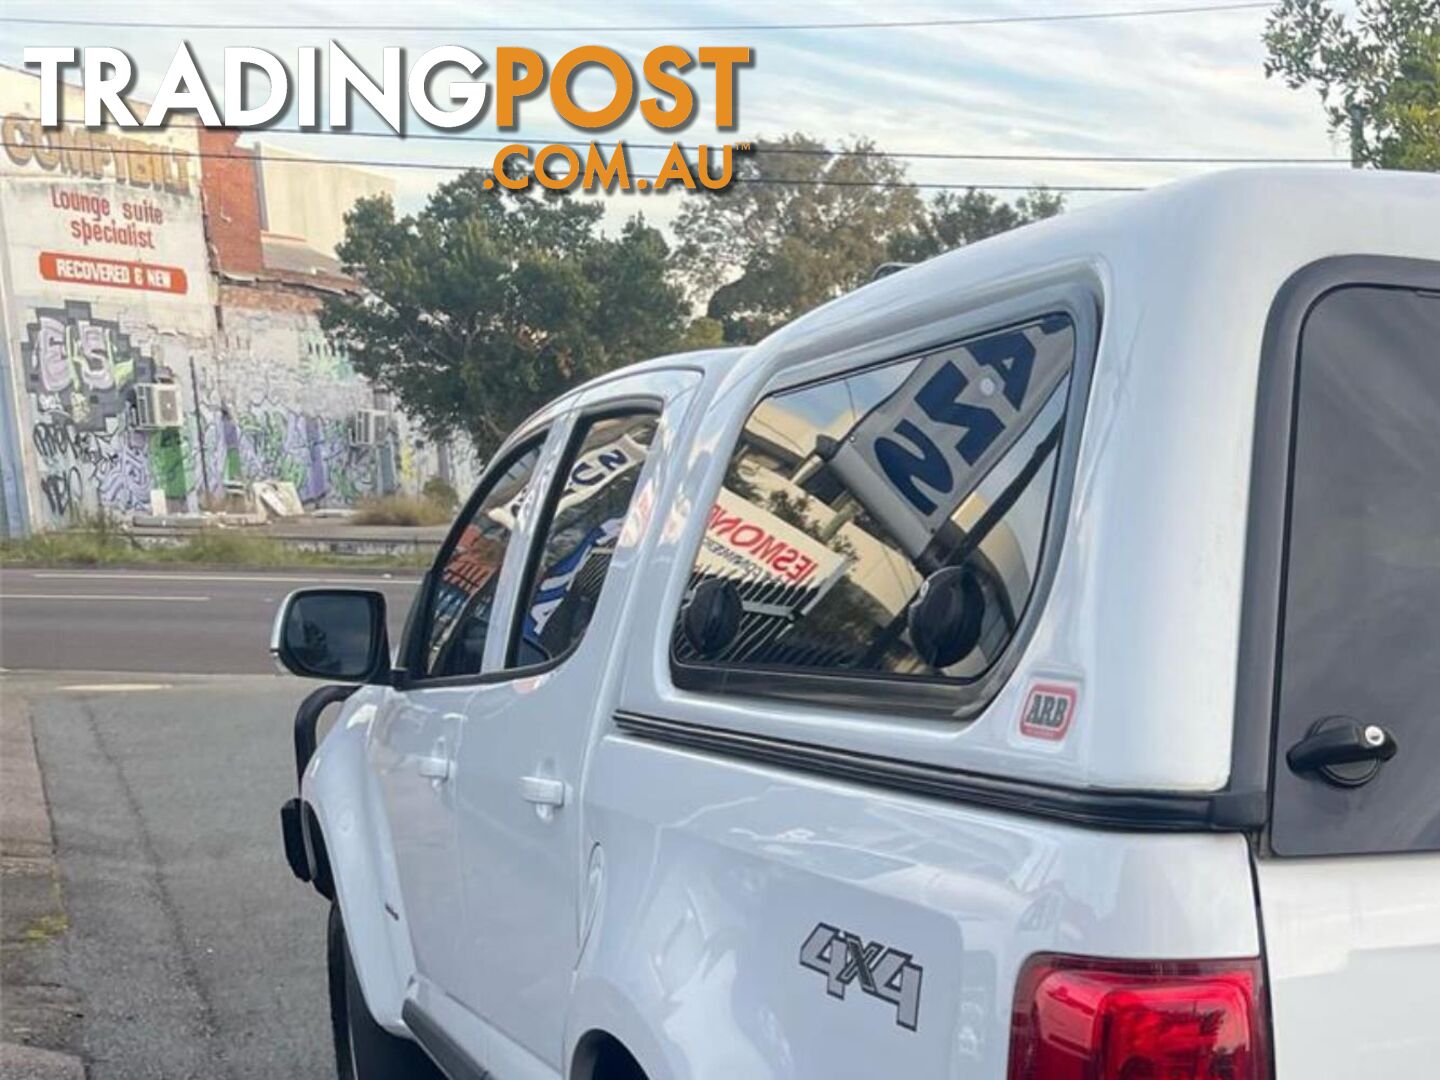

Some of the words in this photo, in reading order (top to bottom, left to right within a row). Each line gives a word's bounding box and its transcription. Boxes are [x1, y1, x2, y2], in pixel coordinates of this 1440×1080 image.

[51, 186, 110, 221] Lounge
[122, 199, 163, 225] suite
[70, 217, 156, 250] specialist
[55, 258, 130, 284] RECOVERED
[147, 268, 172, 288] NEW
[1026, 694, 1068, 727] ARB
